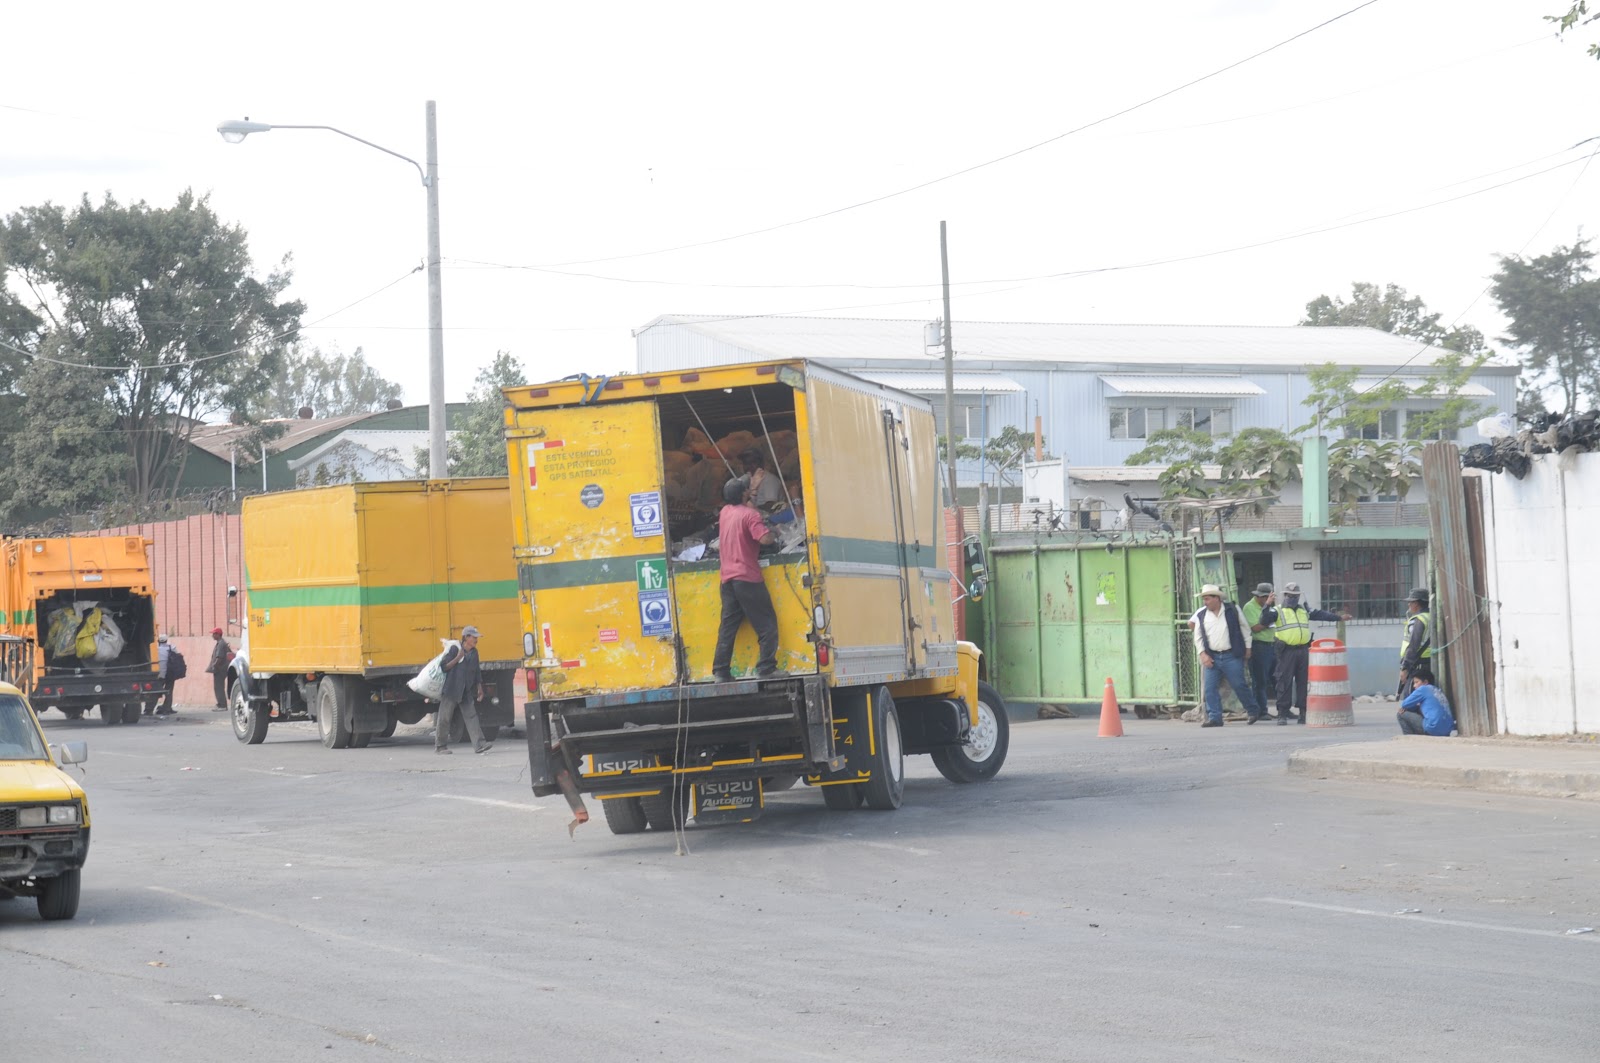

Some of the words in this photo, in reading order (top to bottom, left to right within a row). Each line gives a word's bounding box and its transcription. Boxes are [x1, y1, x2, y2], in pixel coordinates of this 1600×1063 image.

[544, 463, 565, 472] ESTA
[567, 457, 616, 469] PROTEGIDO
[546, 453, 567, 462] ESTE
[549, 472, 567, 481] GPS
[569, 467, 613, 479] SATELITAL
[844, 734, 853, 746] 4
[700, 780, 753, 795] ISUZU
